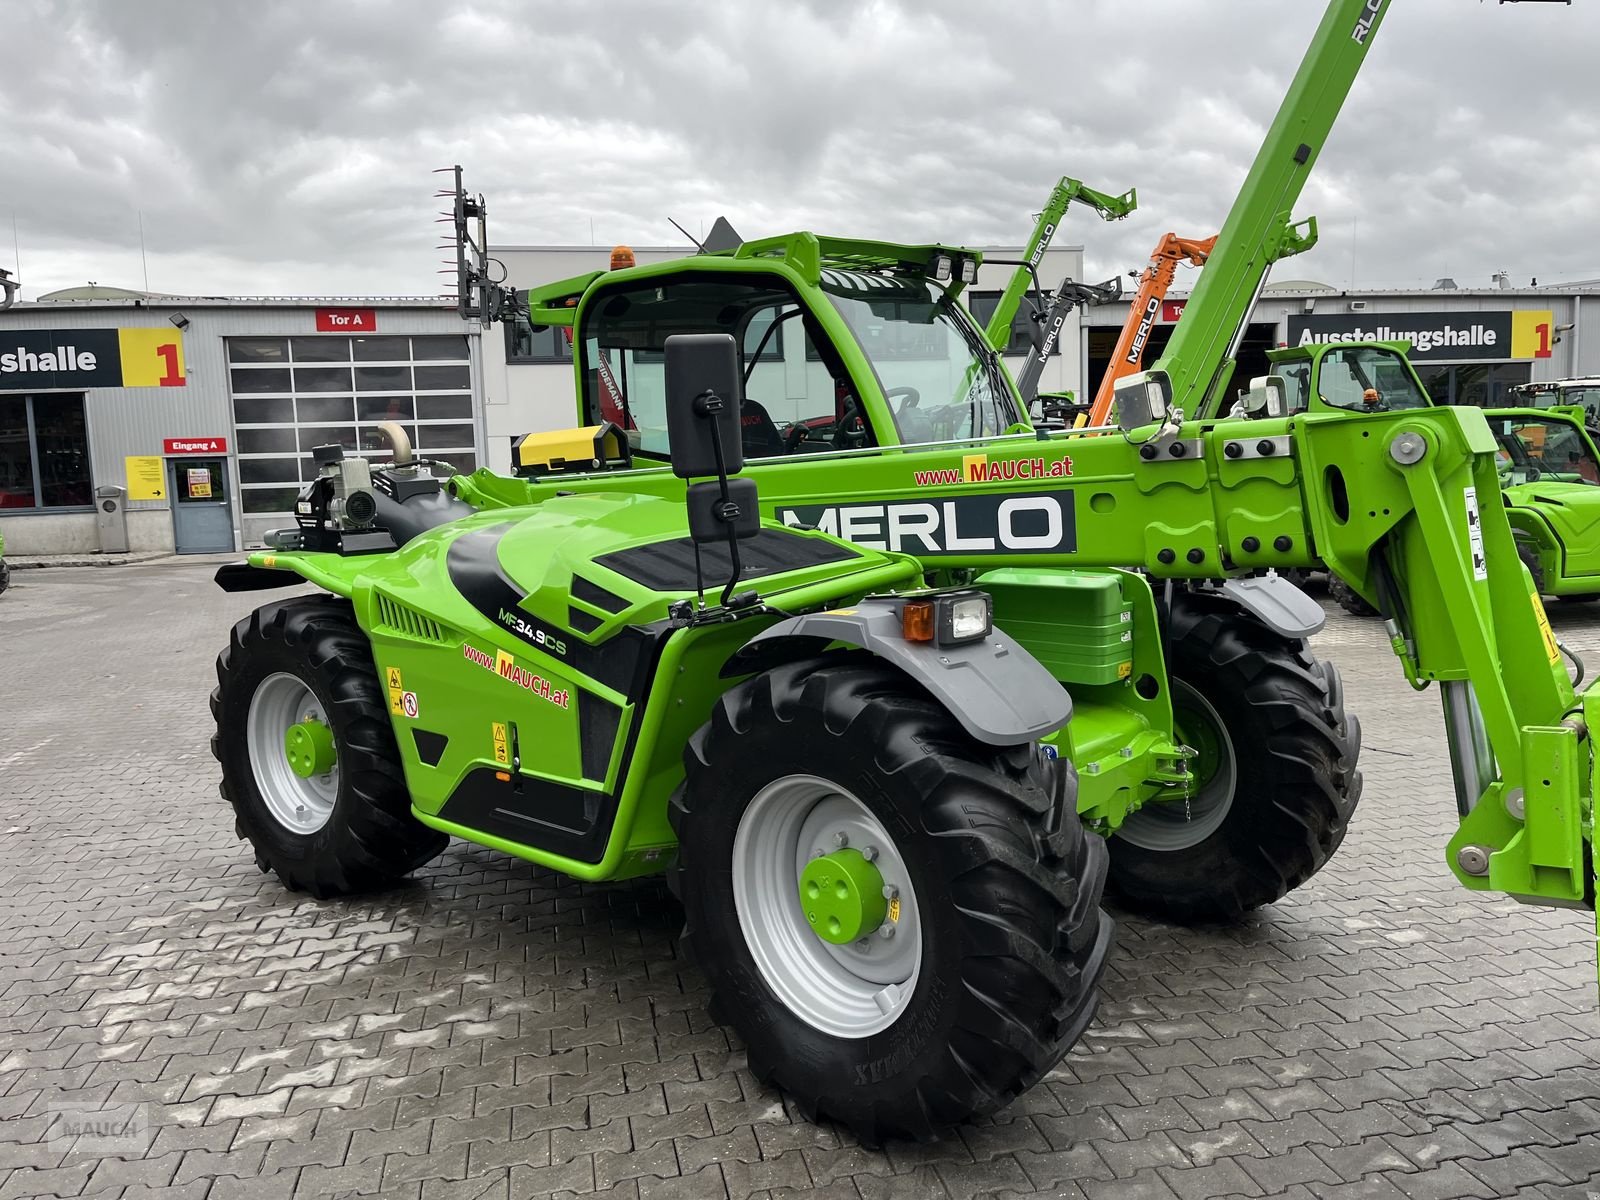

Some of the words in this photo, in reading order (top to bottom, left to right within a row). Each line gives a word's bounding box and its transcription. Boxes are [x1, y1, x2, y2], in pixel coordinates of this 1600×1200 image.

[328, 314, 350, 325] Tor
[352, 314, 363, 325] A
[1038, 316, 1063, 363] MERLO
[1127, 298, 1159, 363] MERLO
[1298, 324, 1496, 352] Ausstellungshalle
[1535, 323, 1552, 358] 1
[0, 346, 97, 372] shalle
[157, 344, 186, 387] 1
[172, 442, 208, 451] Eingang
[210, 441, 217, 449] A
[783, 496, 1063, 551] MERLO
